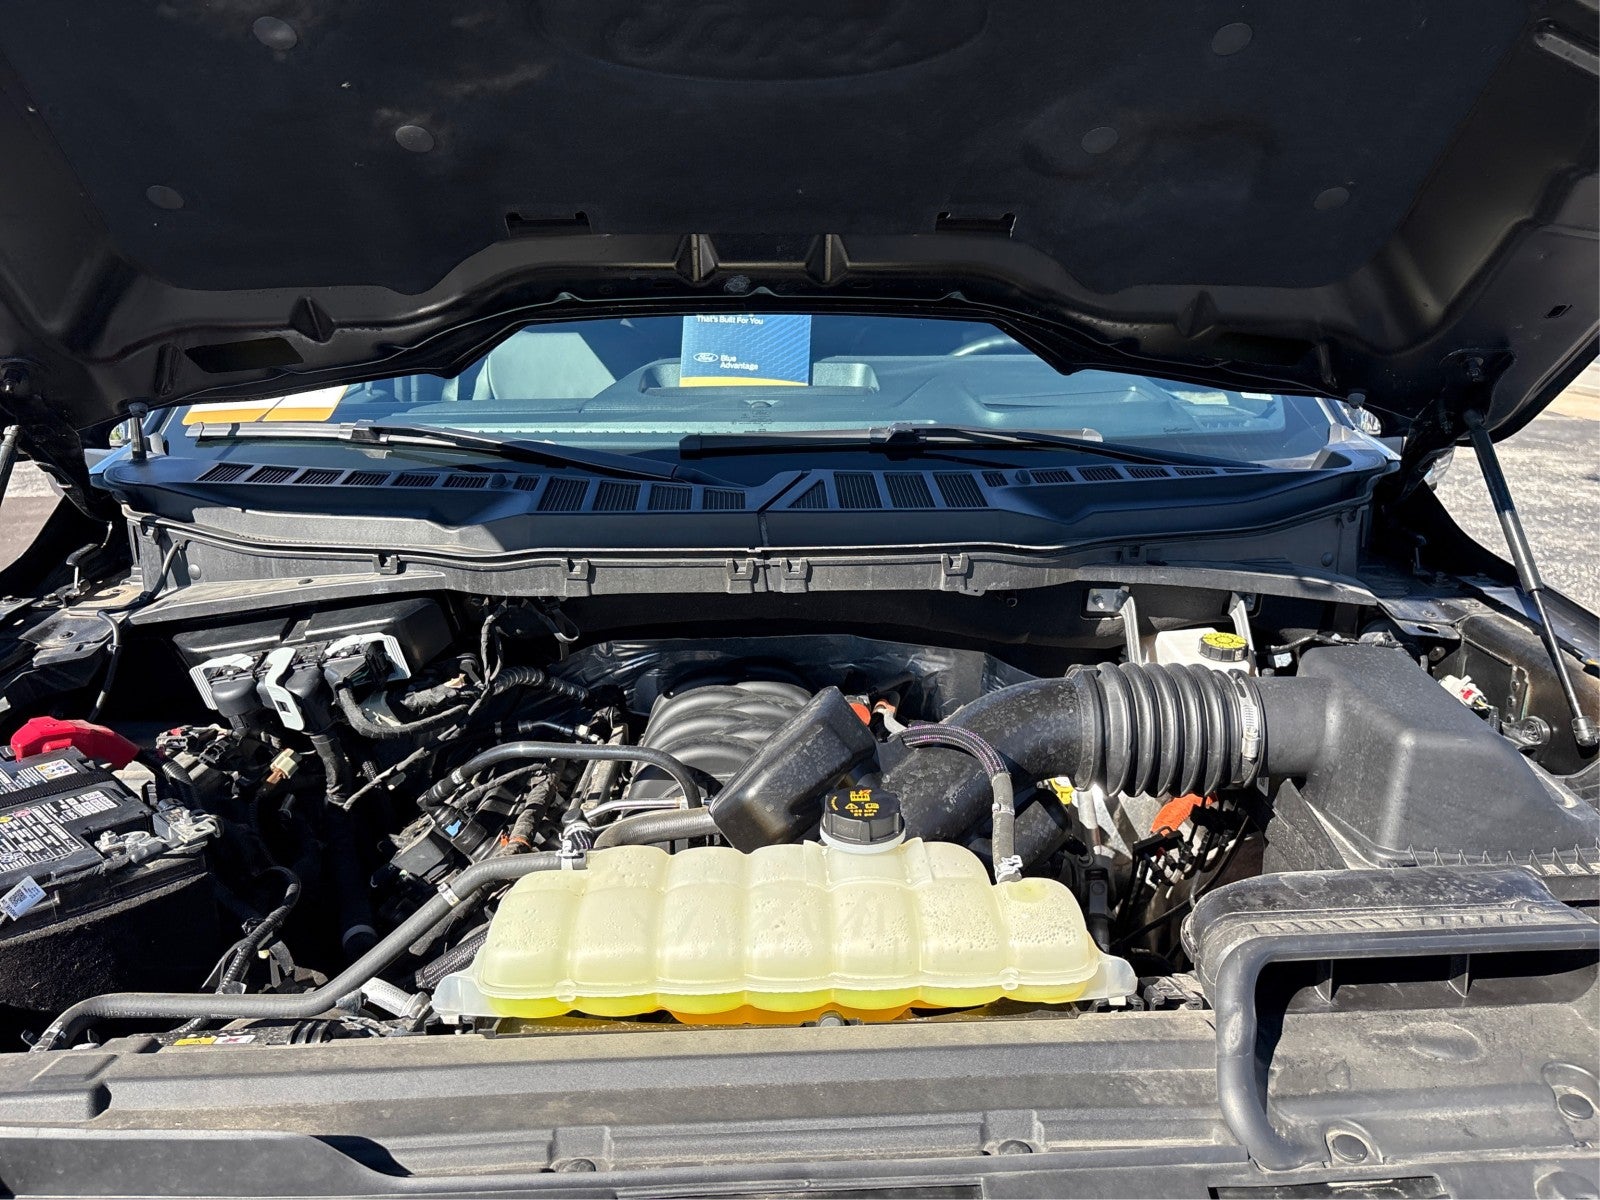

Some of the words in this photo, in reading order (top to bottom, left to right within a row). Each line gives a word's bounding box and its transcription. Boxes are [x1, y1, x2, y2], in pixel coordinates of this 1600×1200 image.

[696, 315, 718, 323] That's
[719, 316, 736, 324] Built
[737, 316, 749, 324] For
[749, 317, 764, 325] You
[720, 354, 737, 362] Blue
[720, 361, 759, 371] Advantage
